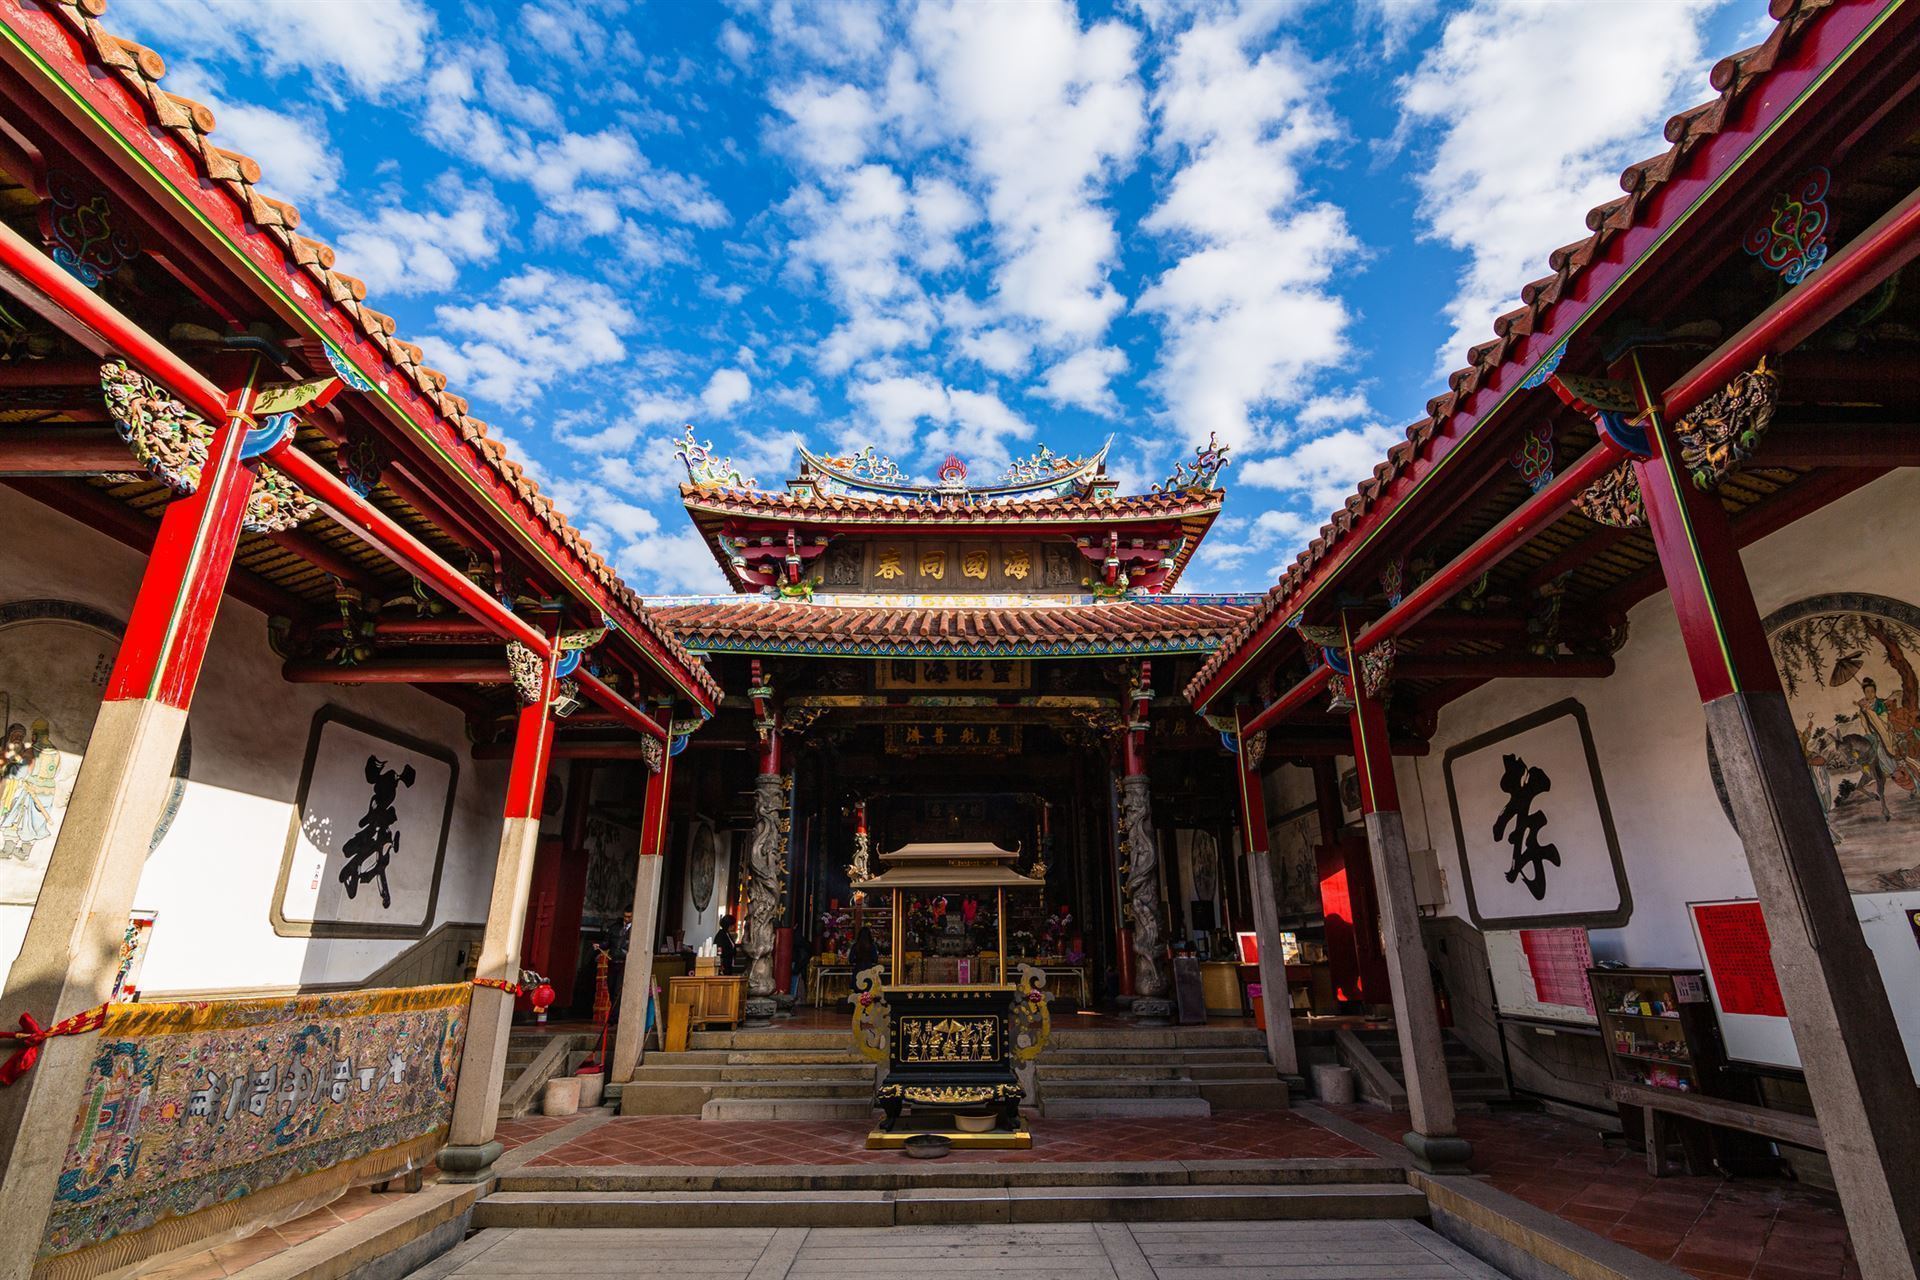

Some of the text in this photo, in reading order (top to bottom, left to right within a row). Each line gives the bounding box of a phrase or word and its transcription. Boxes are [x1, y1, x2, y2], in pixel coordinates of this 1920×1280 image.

[874, 547, 1031, 582] 海國同春
[906, 725, 1001, 745] 慈航普濟
